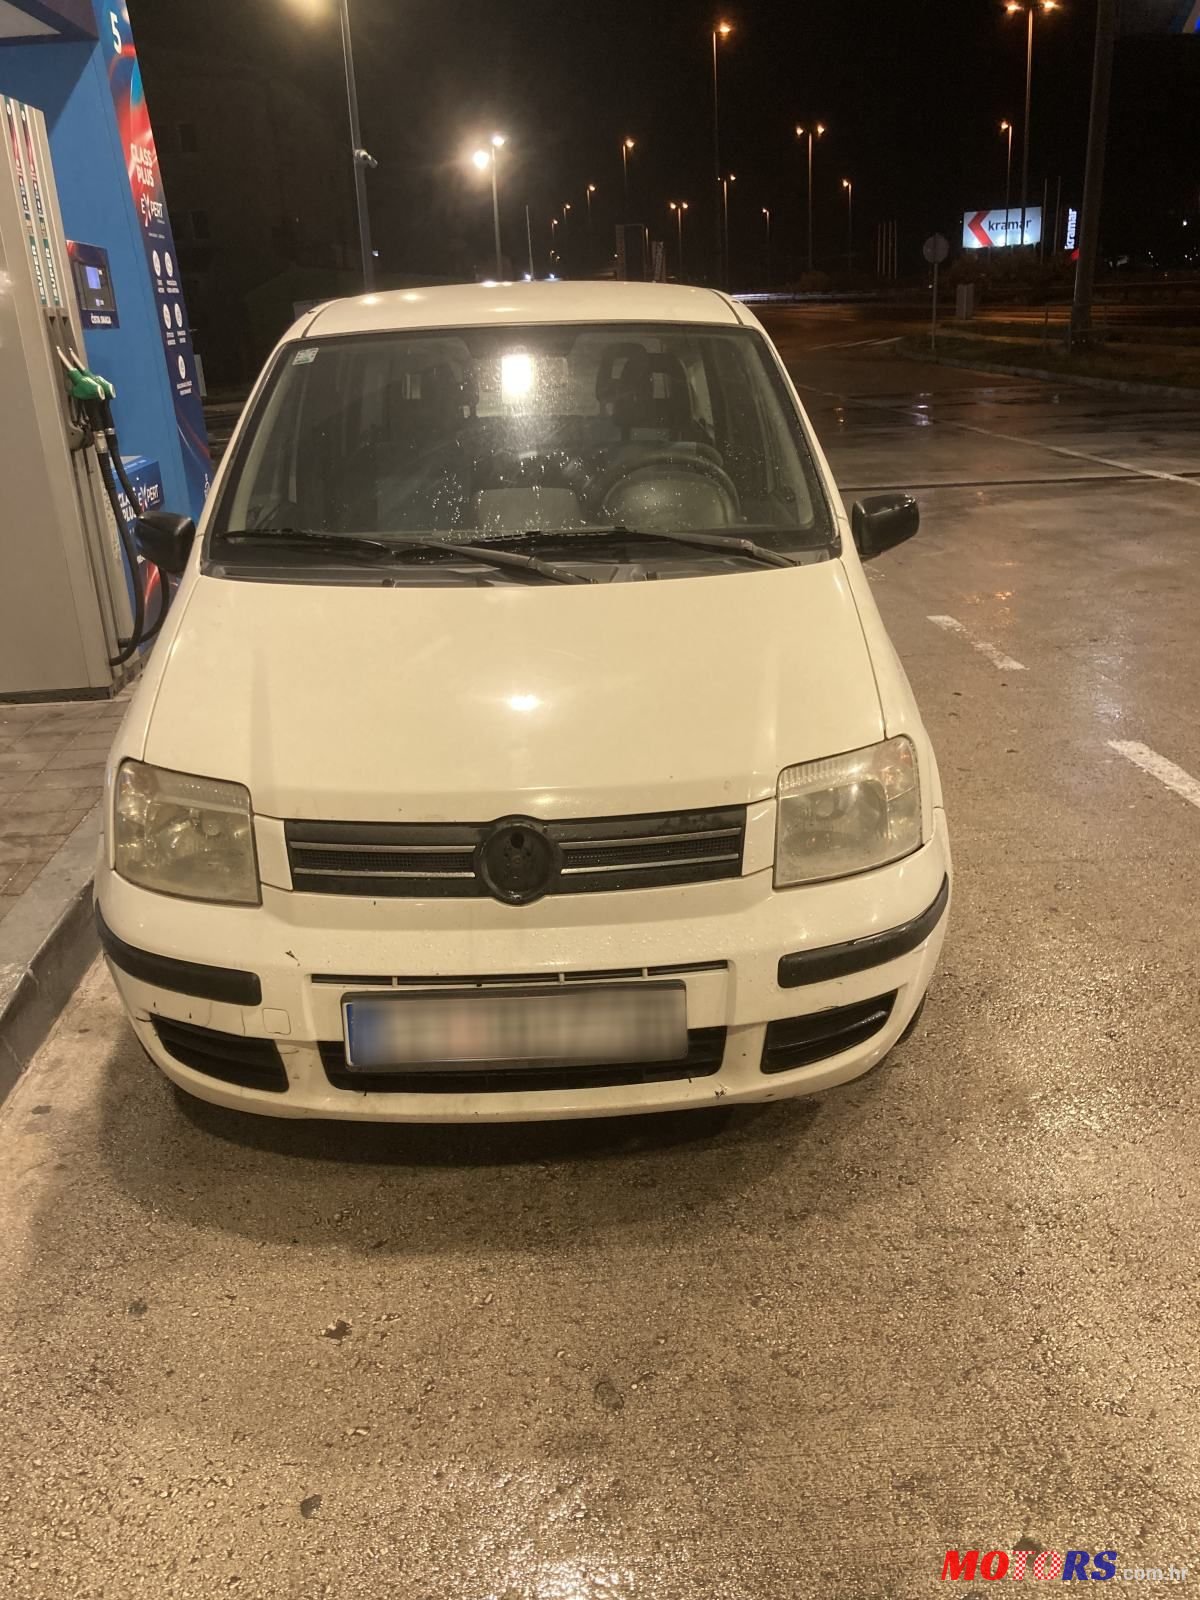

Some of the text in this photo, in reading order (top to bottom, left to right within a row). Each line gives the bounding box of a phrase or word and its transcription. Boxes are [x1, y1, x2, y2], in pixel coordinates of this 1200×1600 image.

[110, 11, 122, 54] 5
[136, 165, 155, 188] PLUS
[1064, 208, 1077, 249] kramar
